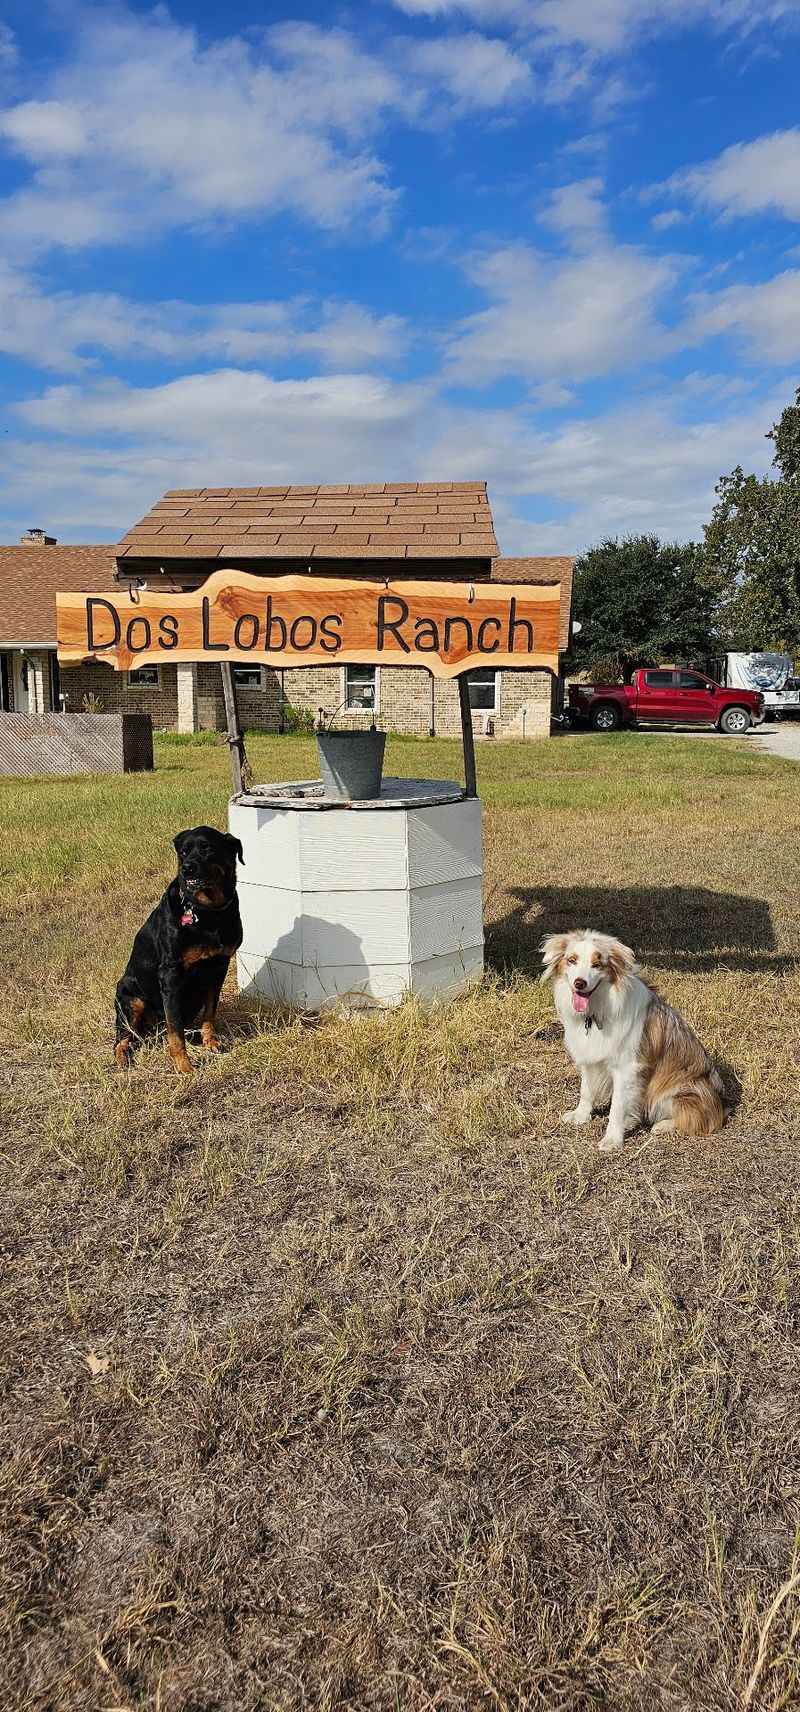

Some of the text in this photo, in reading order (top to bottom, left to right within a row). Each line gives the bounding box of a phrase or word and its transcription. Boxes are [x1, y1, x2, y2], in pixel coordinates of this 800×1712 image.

[86, 595, 533, 654] Dos Lobos Ranch
